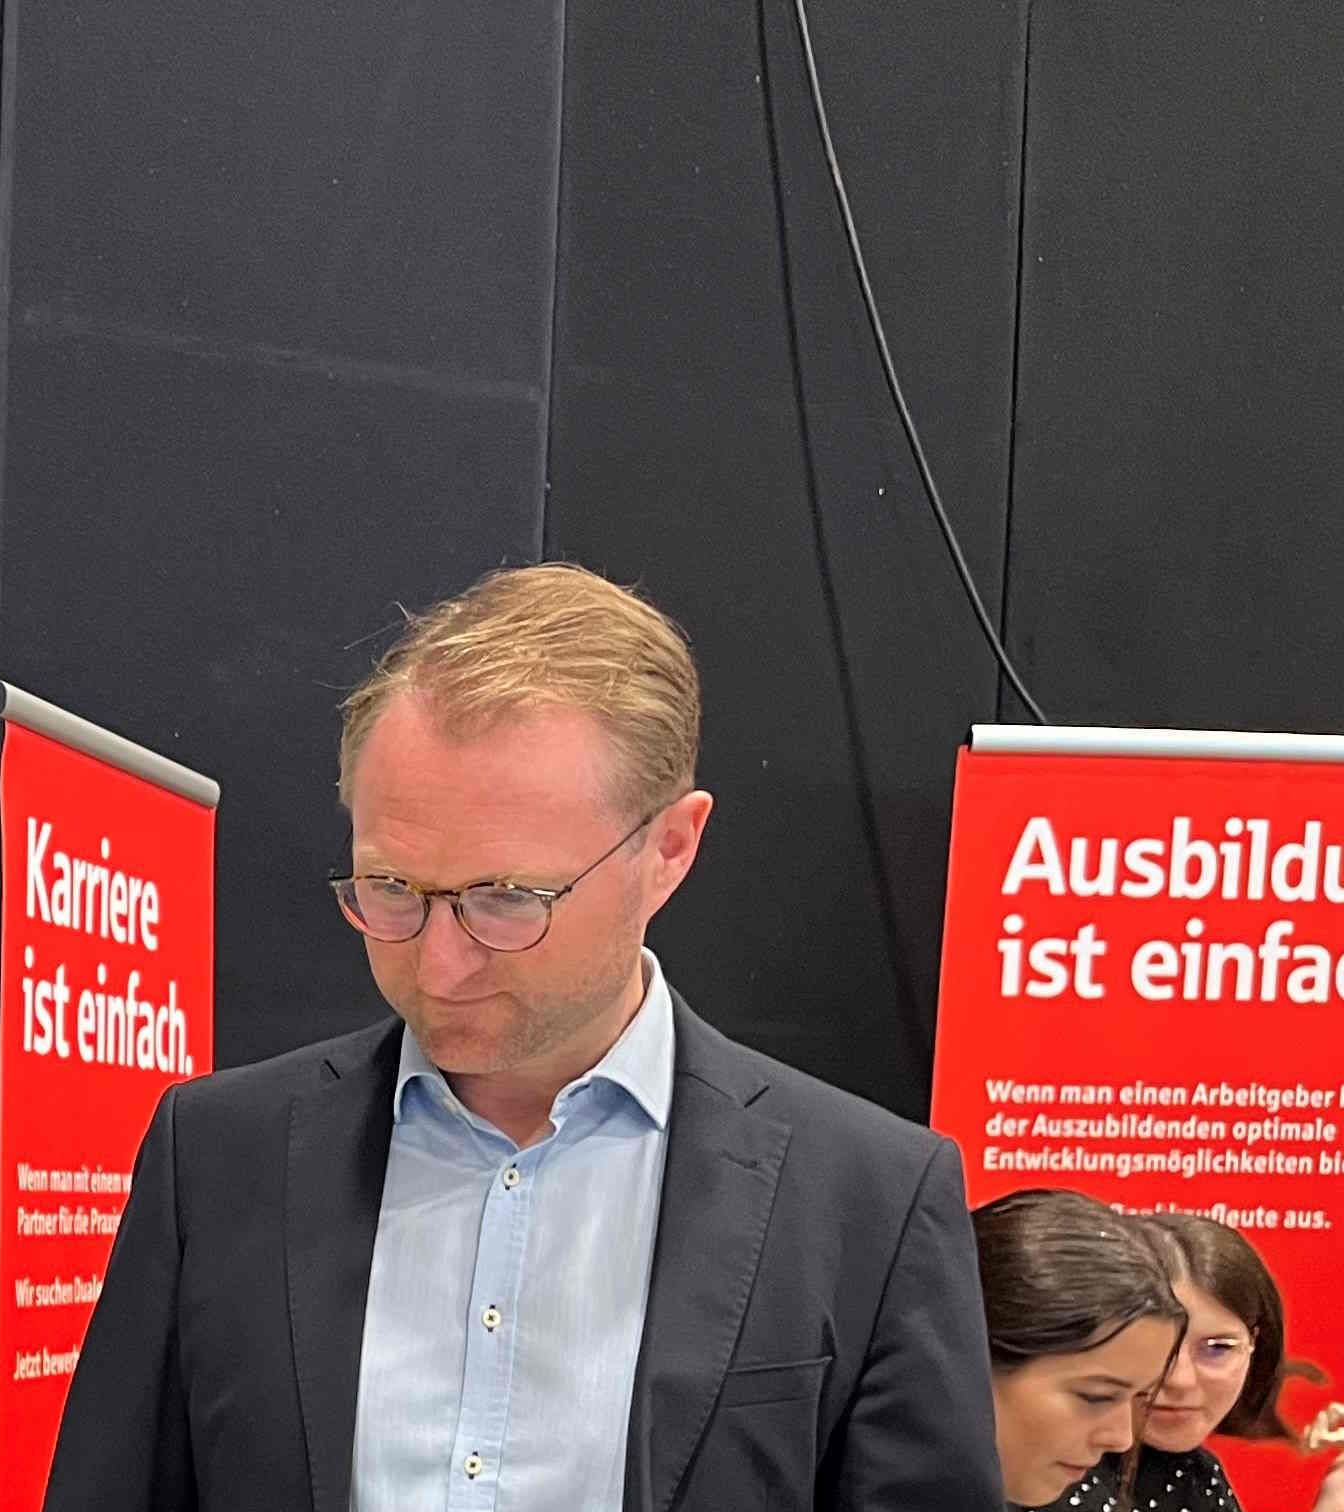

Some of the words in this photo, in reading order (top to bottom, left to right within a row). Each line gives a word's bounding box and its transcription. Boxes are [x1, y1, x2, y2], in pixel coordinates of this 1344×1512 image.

[26, 816, 159, 952] Karriere
[998, 913, 1108, 1000] ist
[1130, 917, 1344, 1004] einfa
[23, 945, 70, 1059] ist
[77, 962, 193, 1077] einfach.
[985, 1079, 1055, 1104] Wenn
[1059, 1084, 1114, 1105] man
[1119, 1080, 1187, 1106] einen
[1191, 1081, 1336, 1113] Arbeitgeber
[985, 1112, 1030, 1138] der
[1031, 1113, 1227, 1140] Auszubildenden
[1231, 1116, 1337, 1146] optimale
[17, 1162, 48, 1192] Wenn
[49, 1169, 73, 1193] man
[73, 1164, 90, 1193] mit
[90, 1164, 121, 1194] einem
[983, 1146, 1314, 1179] Entwicklungsmöglichkeiten
[1318, 1150, 1344, 1175] bi
[17, 1206, 58, 1236] Partner
[59, 1205, 74, 1236] für
[74, 1205, 89, 1236] die
[1283, 1210, 1332, 1229] aus.
[15, 1277, 35, 1308] Wir
[35, 1276, 73, 1307] suchen
[14, 1350, 41, 1381] Jetzt
